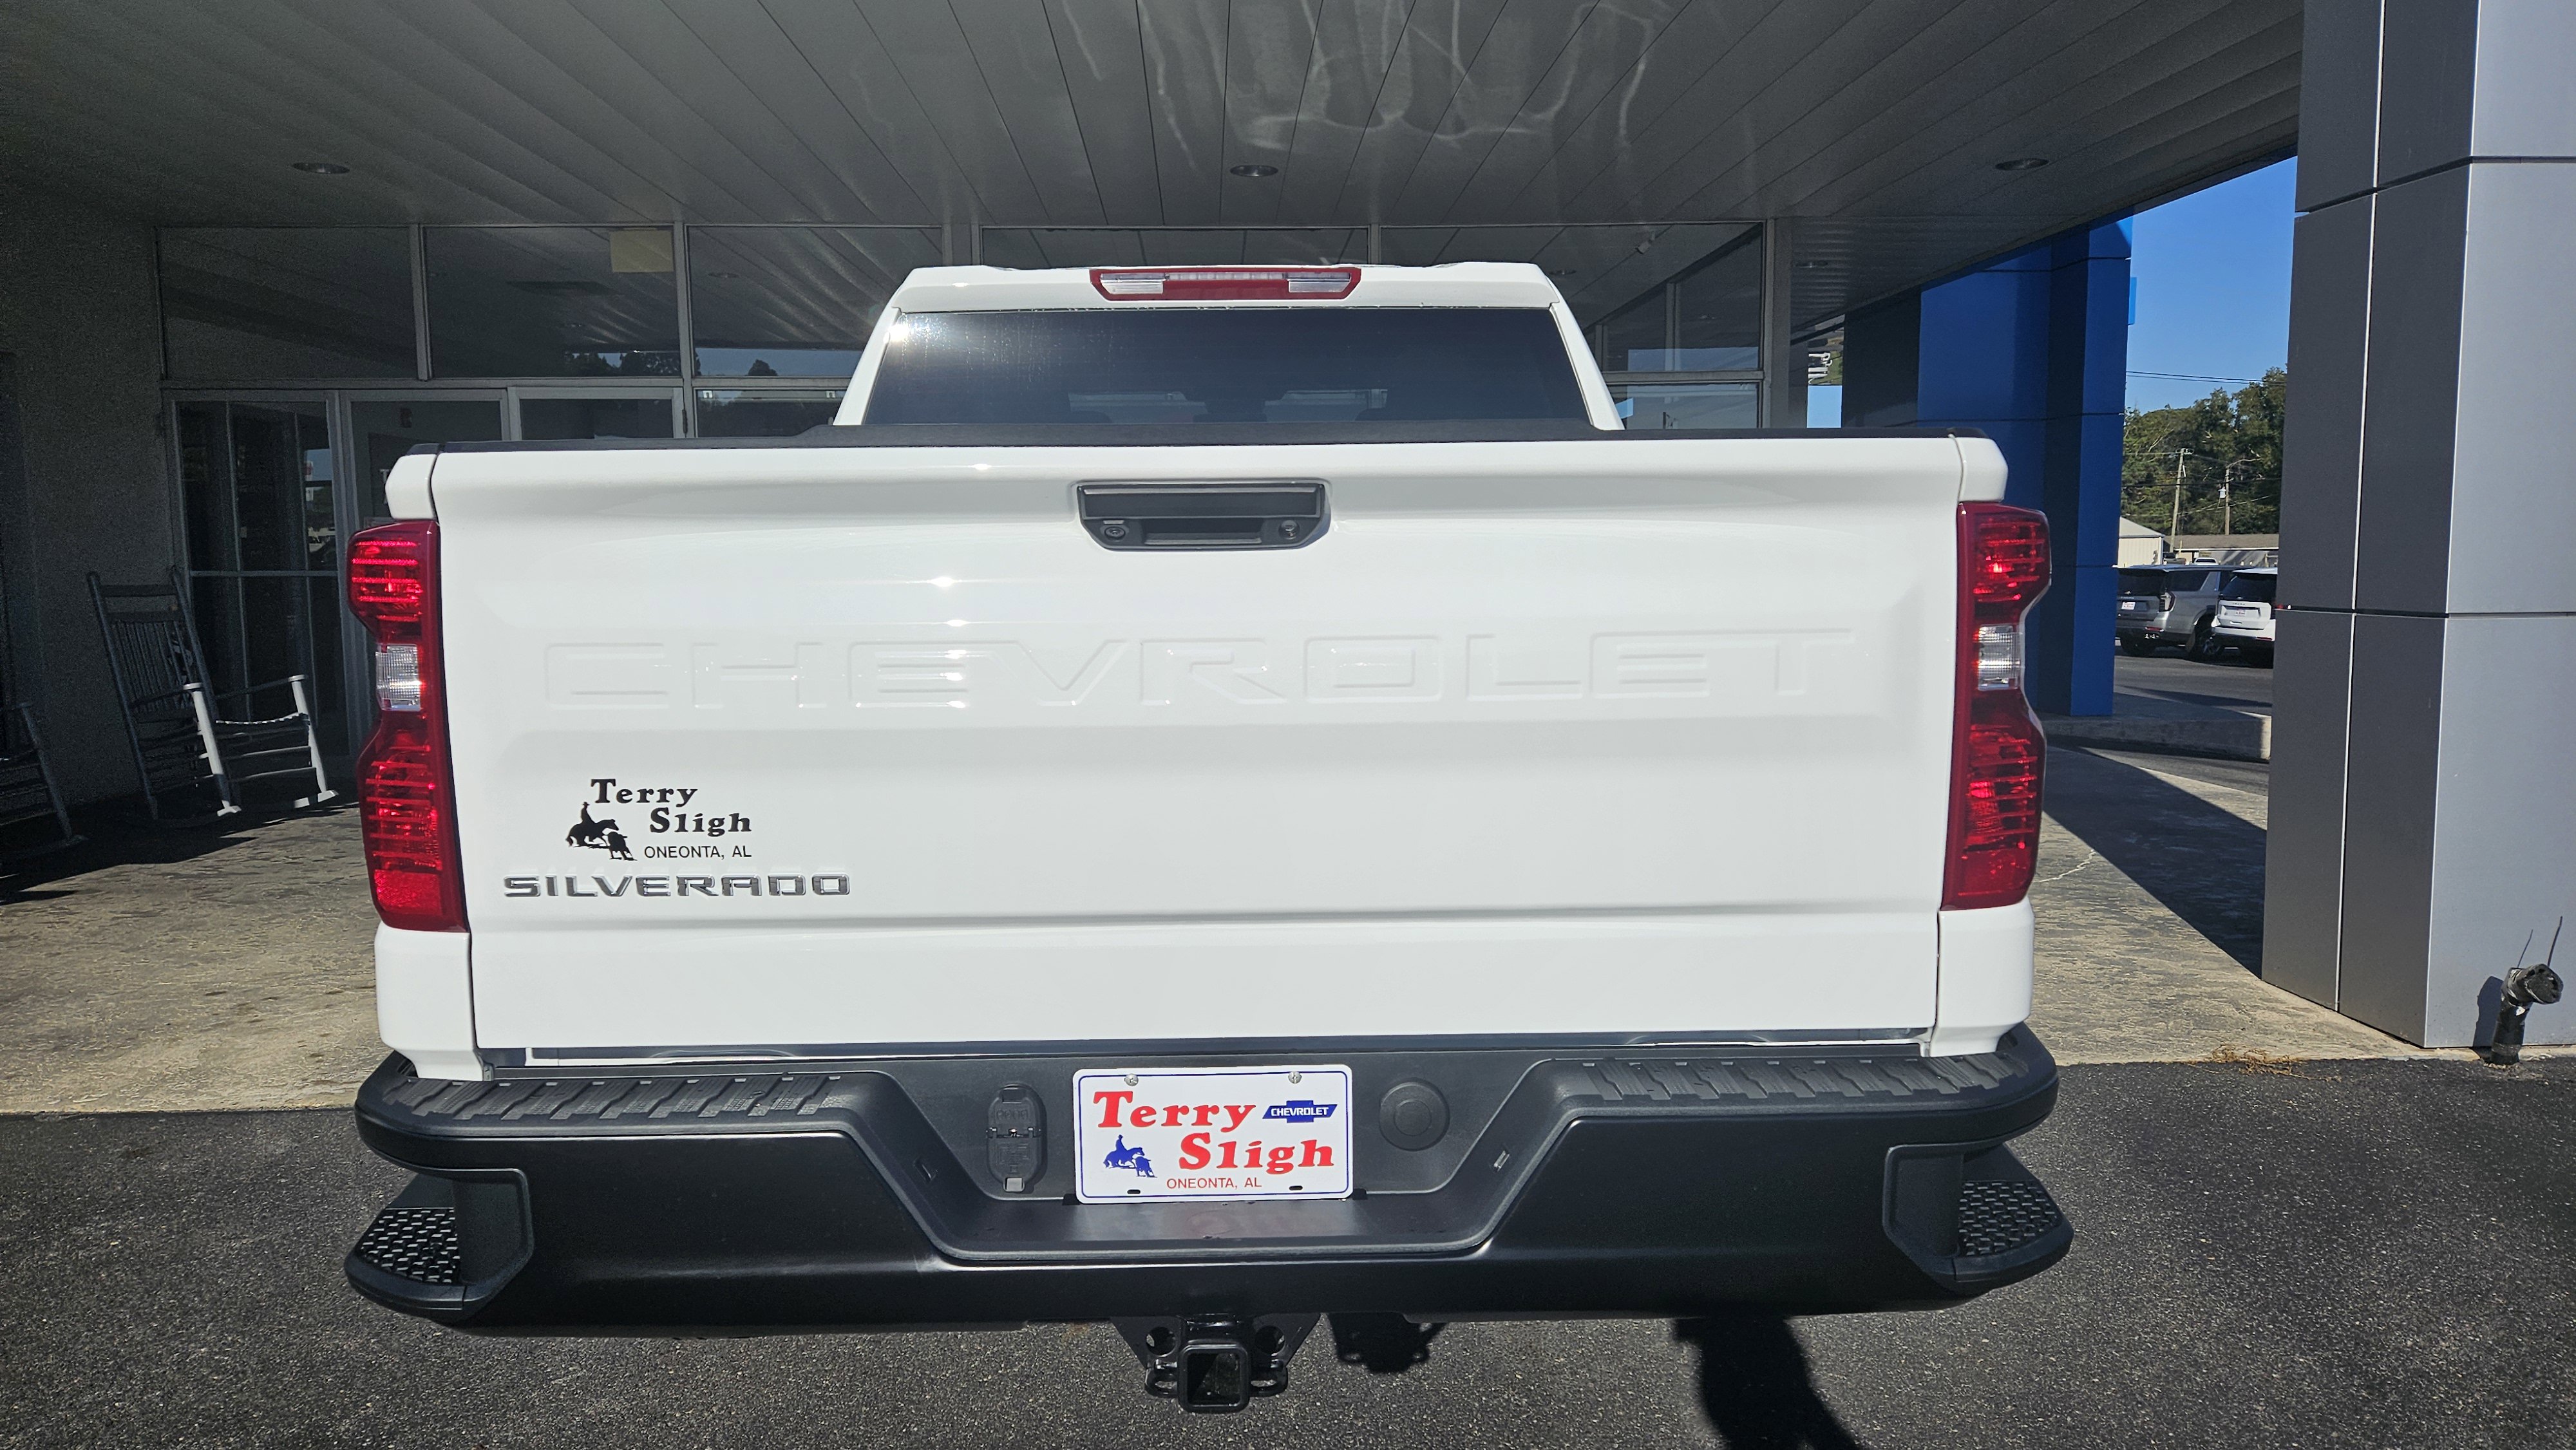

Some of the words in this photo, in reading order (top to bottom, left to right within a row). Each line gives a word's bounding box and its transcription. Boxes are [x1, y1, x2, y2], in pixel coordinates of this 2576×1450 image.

[544, 628, 1857, 710] CHEVROLET
[591, 778, 698, 807] Terry
[649, 807, 752, 837] Sligh
[644, 845, 724, 860] ONEONTA,
[732, 845, 752, 858] AL
[503, 873, 851, 898] SILVERADO
[1093, 1091, 1256, 1133] Terry
[1270, 1106, 1329, 1117] CHEVROLET
[1179, 1132, 1334, 1175] Sligh
[1166, 1178, 1238, 1190] ONEONTA,
[1244, 1177, 1262, 1188] AL
